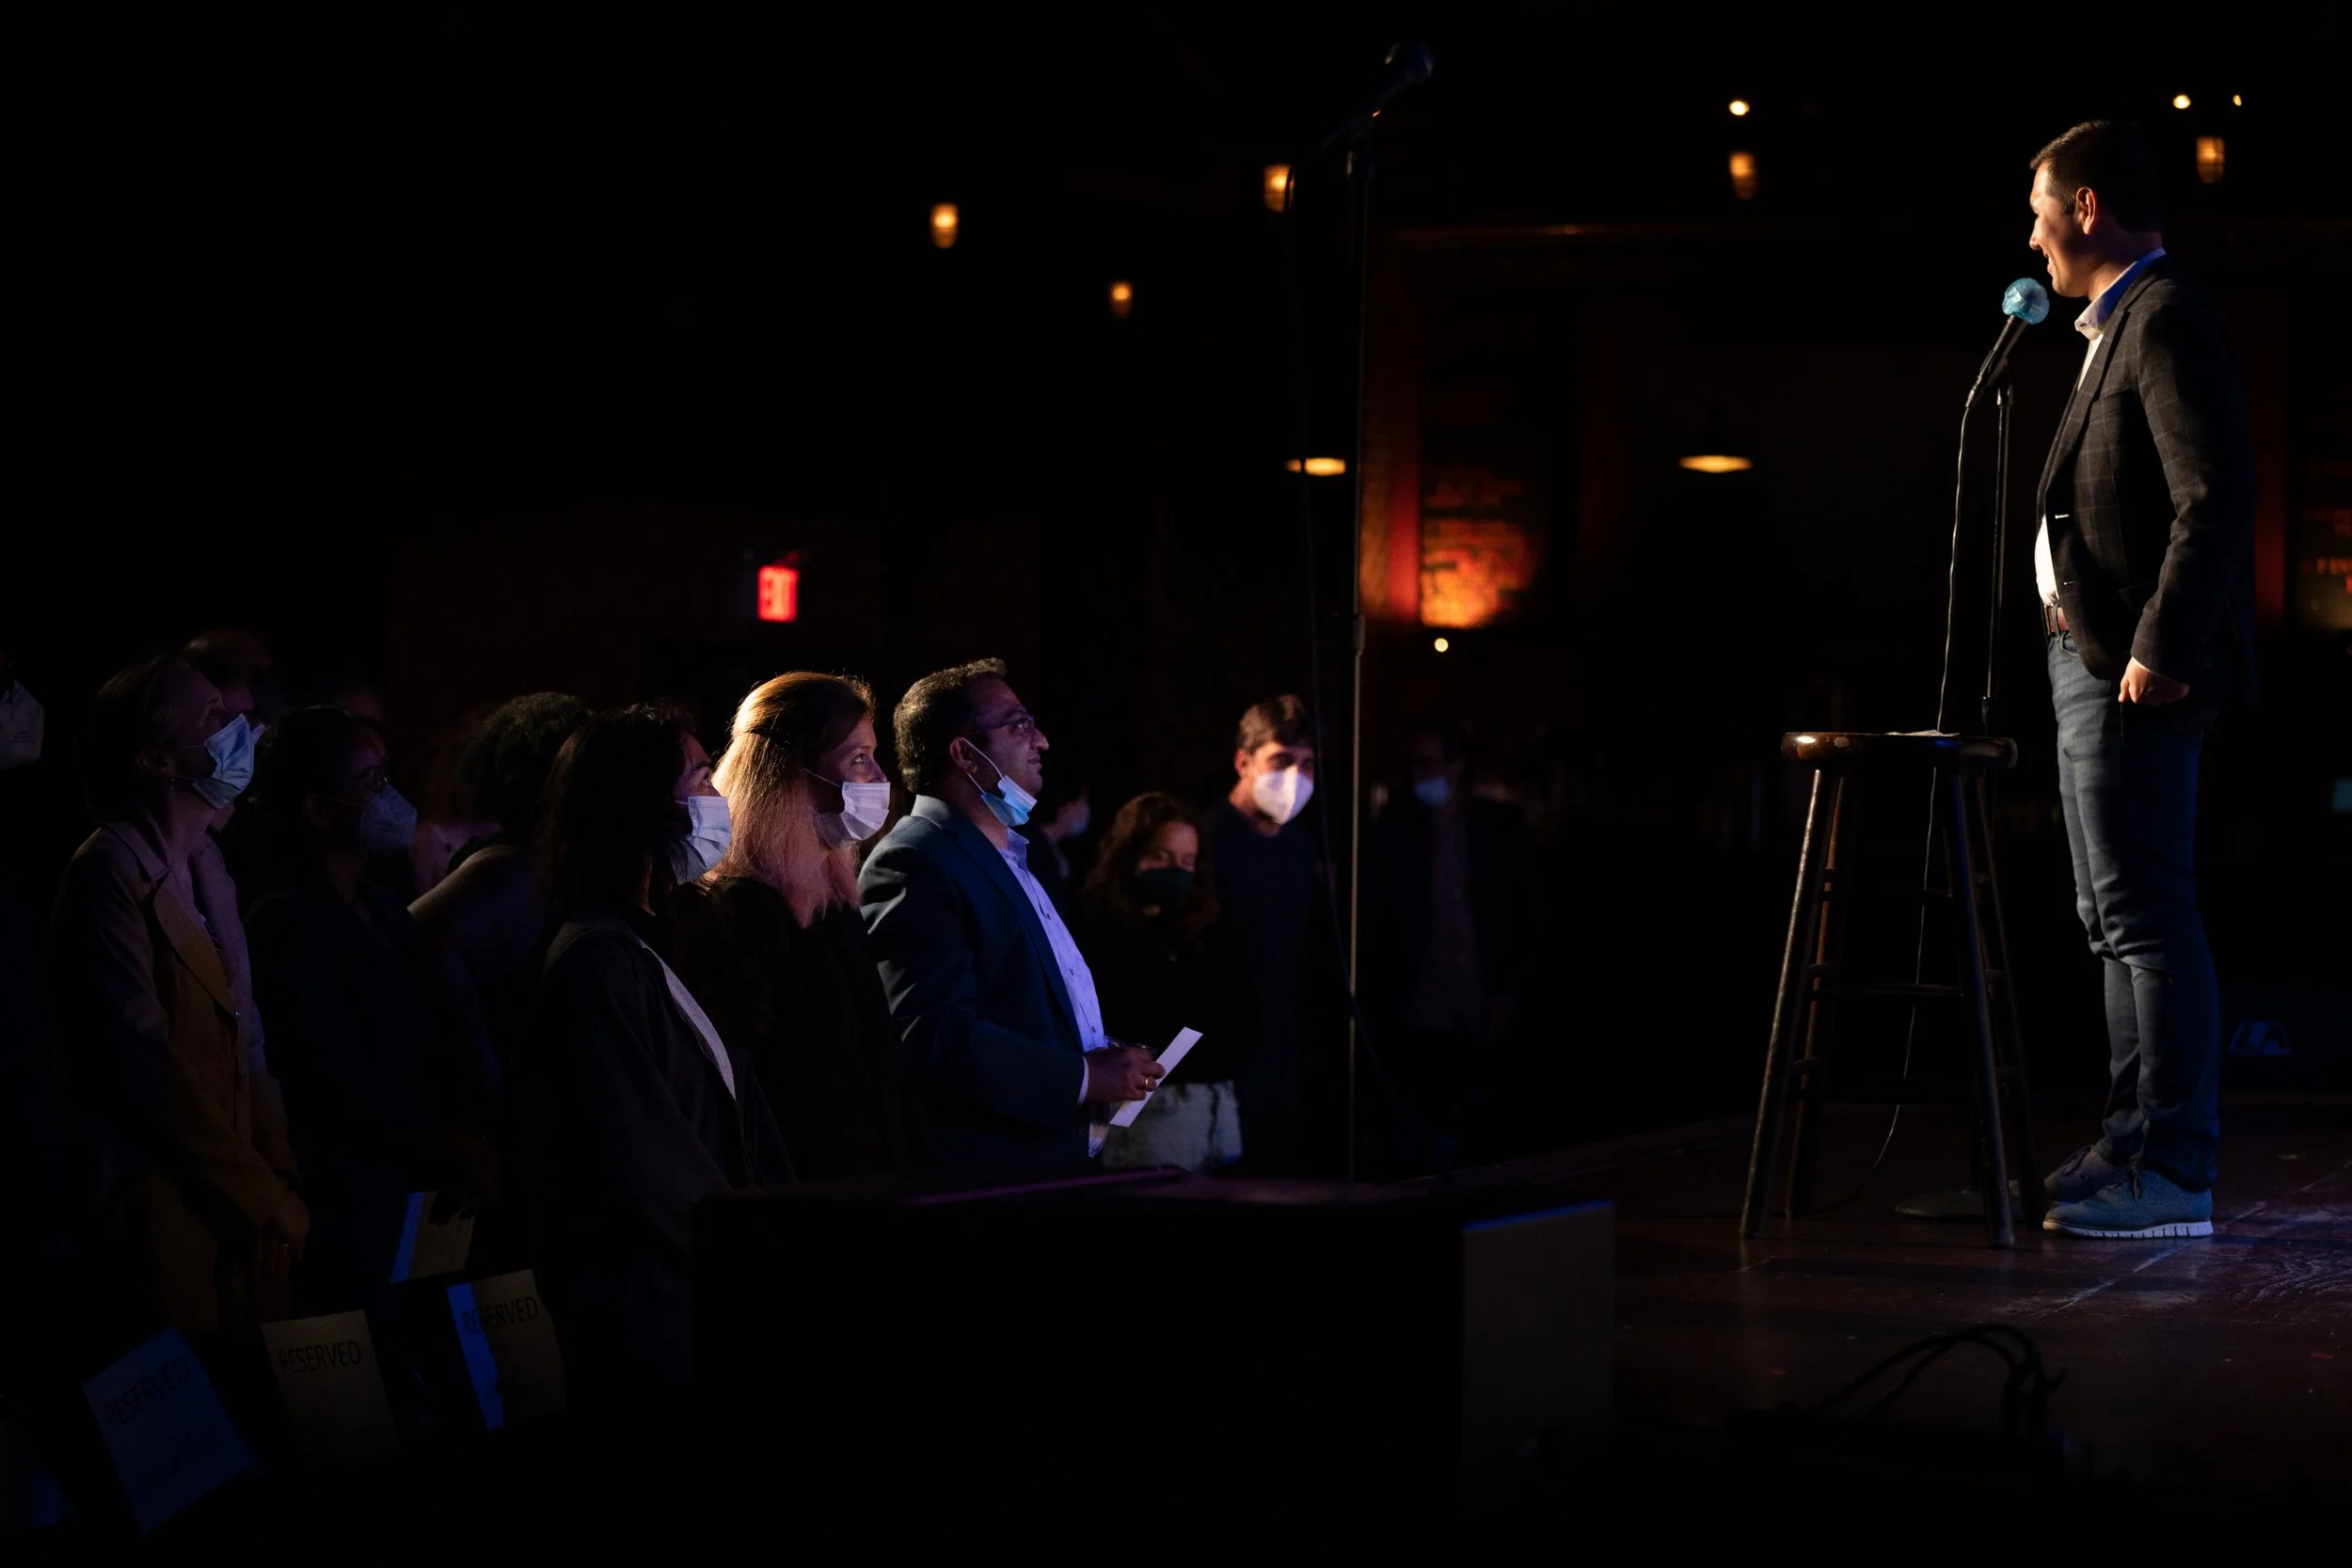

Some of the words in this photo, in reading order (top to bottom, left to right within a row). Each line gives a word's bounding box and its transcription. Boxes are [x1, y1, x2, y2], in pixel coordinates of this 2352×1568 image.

[462, 1296, 539, 1336] RESERVED
[278, 1339, 363, 1375] RESERVED
[103, 1357, 191, 1431] RESERVED
